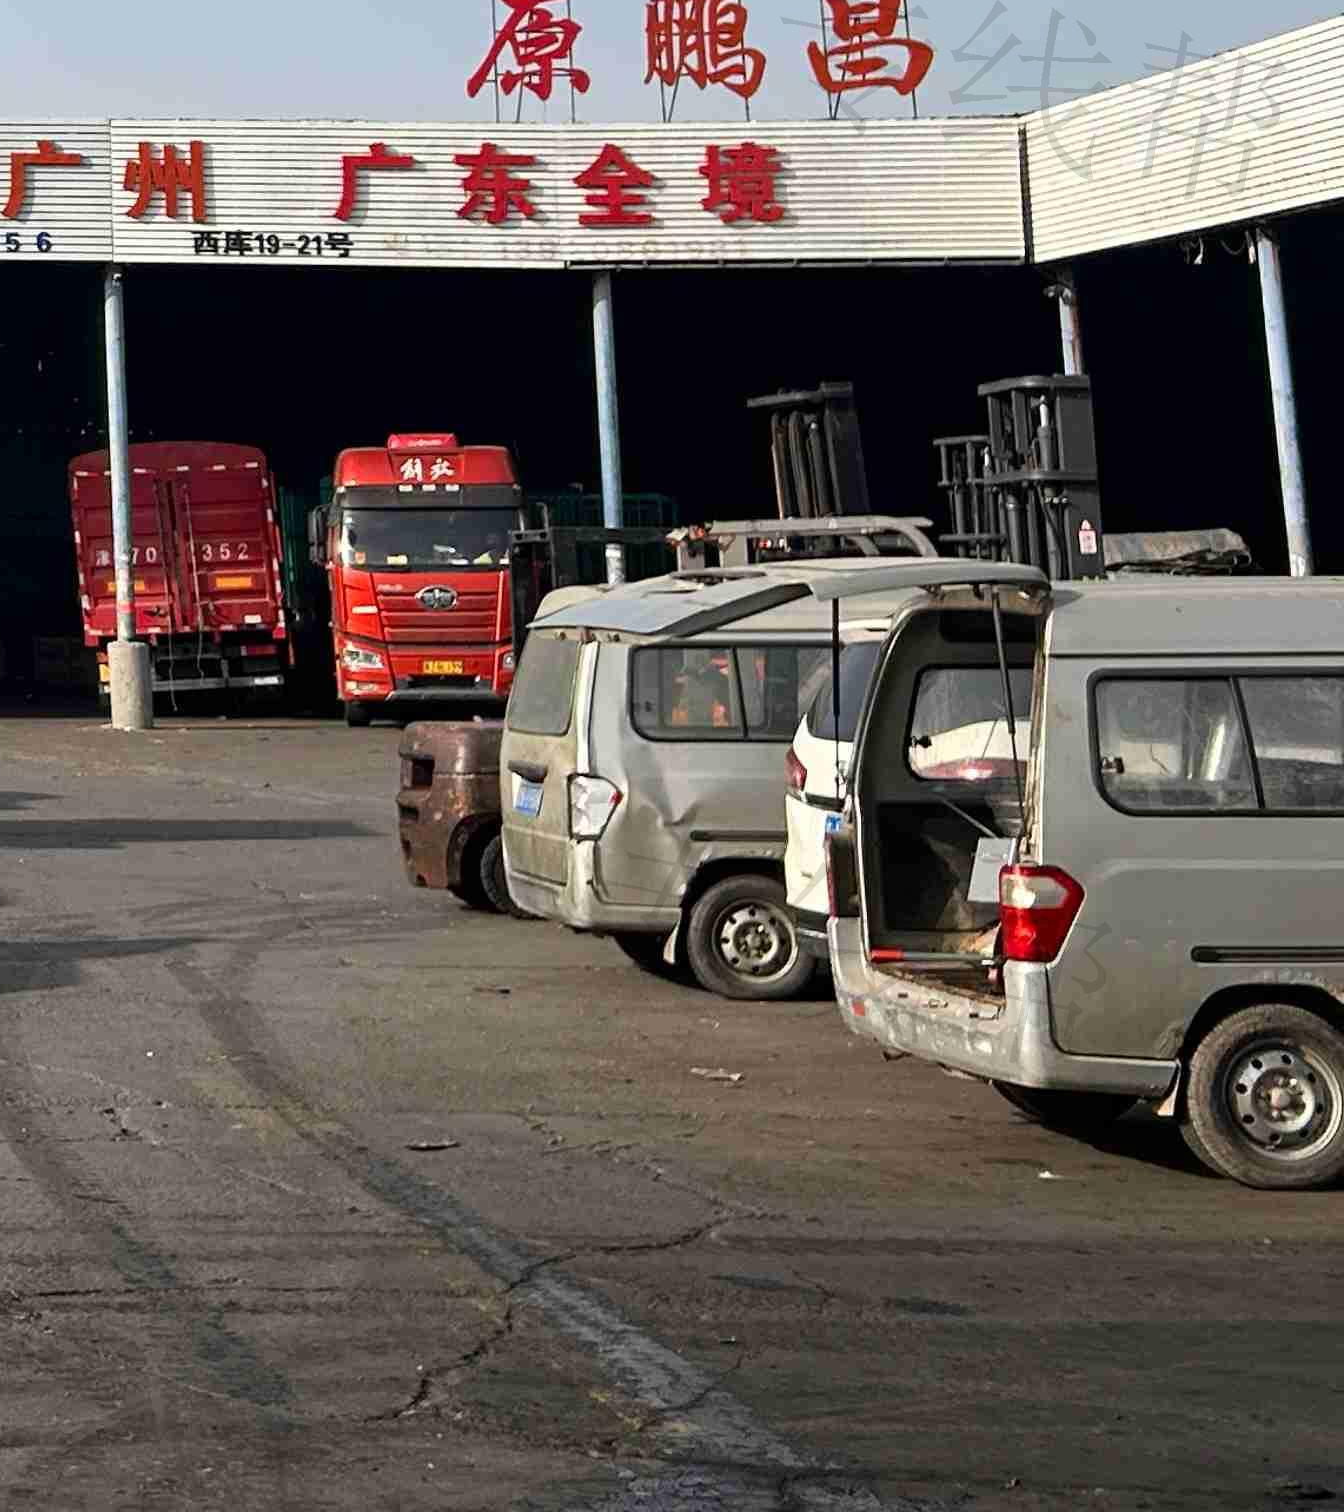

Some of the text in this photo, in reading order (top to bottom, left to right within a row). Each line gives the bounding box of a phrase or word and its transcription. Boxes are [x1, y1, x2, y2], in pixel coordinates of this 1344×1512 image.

[2, 140, 210, 222] 广州
[334, 141, 787, 227] 广东全境
[192, 231, 354, 259] 西库19-21号
[201, 542, 250, 562] 352
